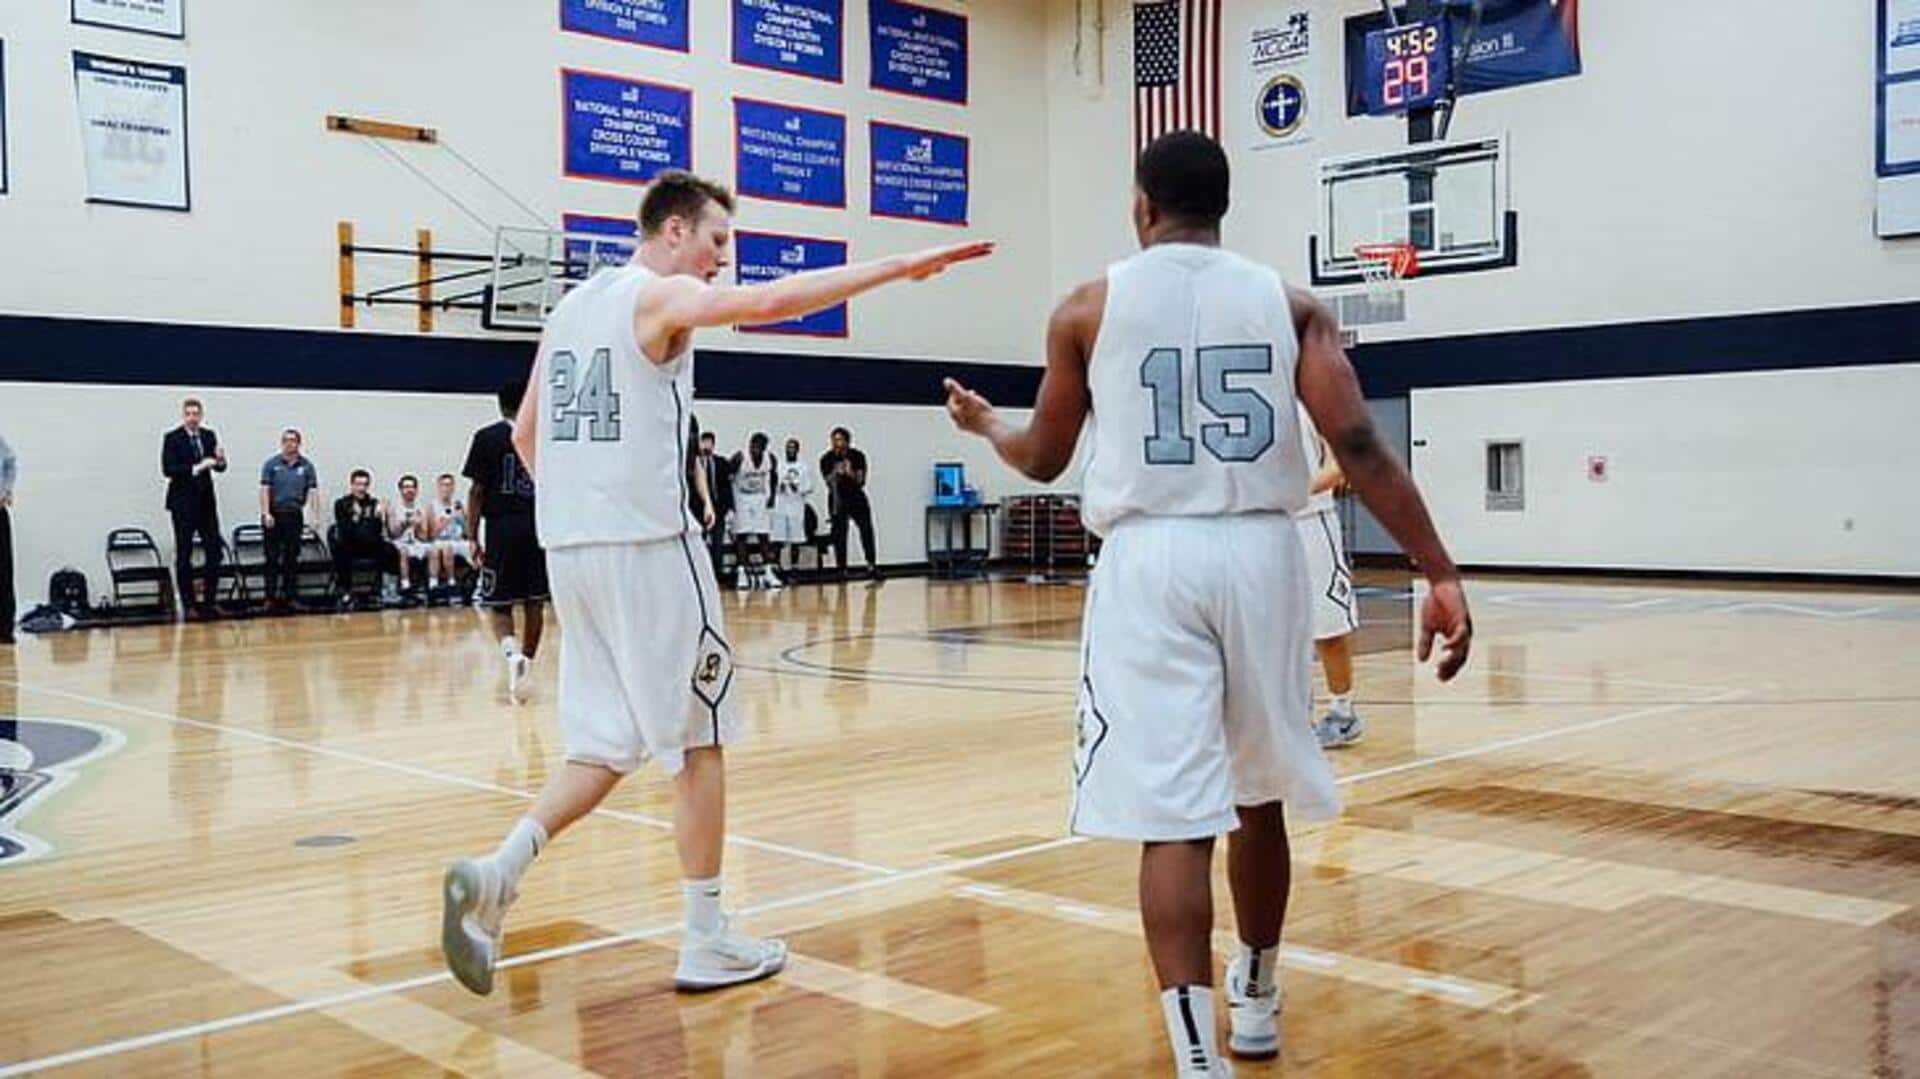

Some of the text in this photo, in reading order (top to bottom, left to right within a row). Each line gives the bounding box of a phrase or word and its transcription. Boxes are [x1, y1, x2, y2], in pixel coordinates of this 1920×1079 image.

[756, 21, 821, 43] CROSS COUNTRY
[1386, 26, 1438, 56] 4:52
[1384, 55, 1428, 105] 29
[574, 99, 683, 128] NATIONAL INVITATIONAL
[589, 141, 629, 157] DIVISION
[637, 148, 671, 164] WOMEN
[591, 128, 668, 150] CROSS COUNTRY
[549, 348, 621, 441] 24
[1139, 343, 1274, 465] 15
